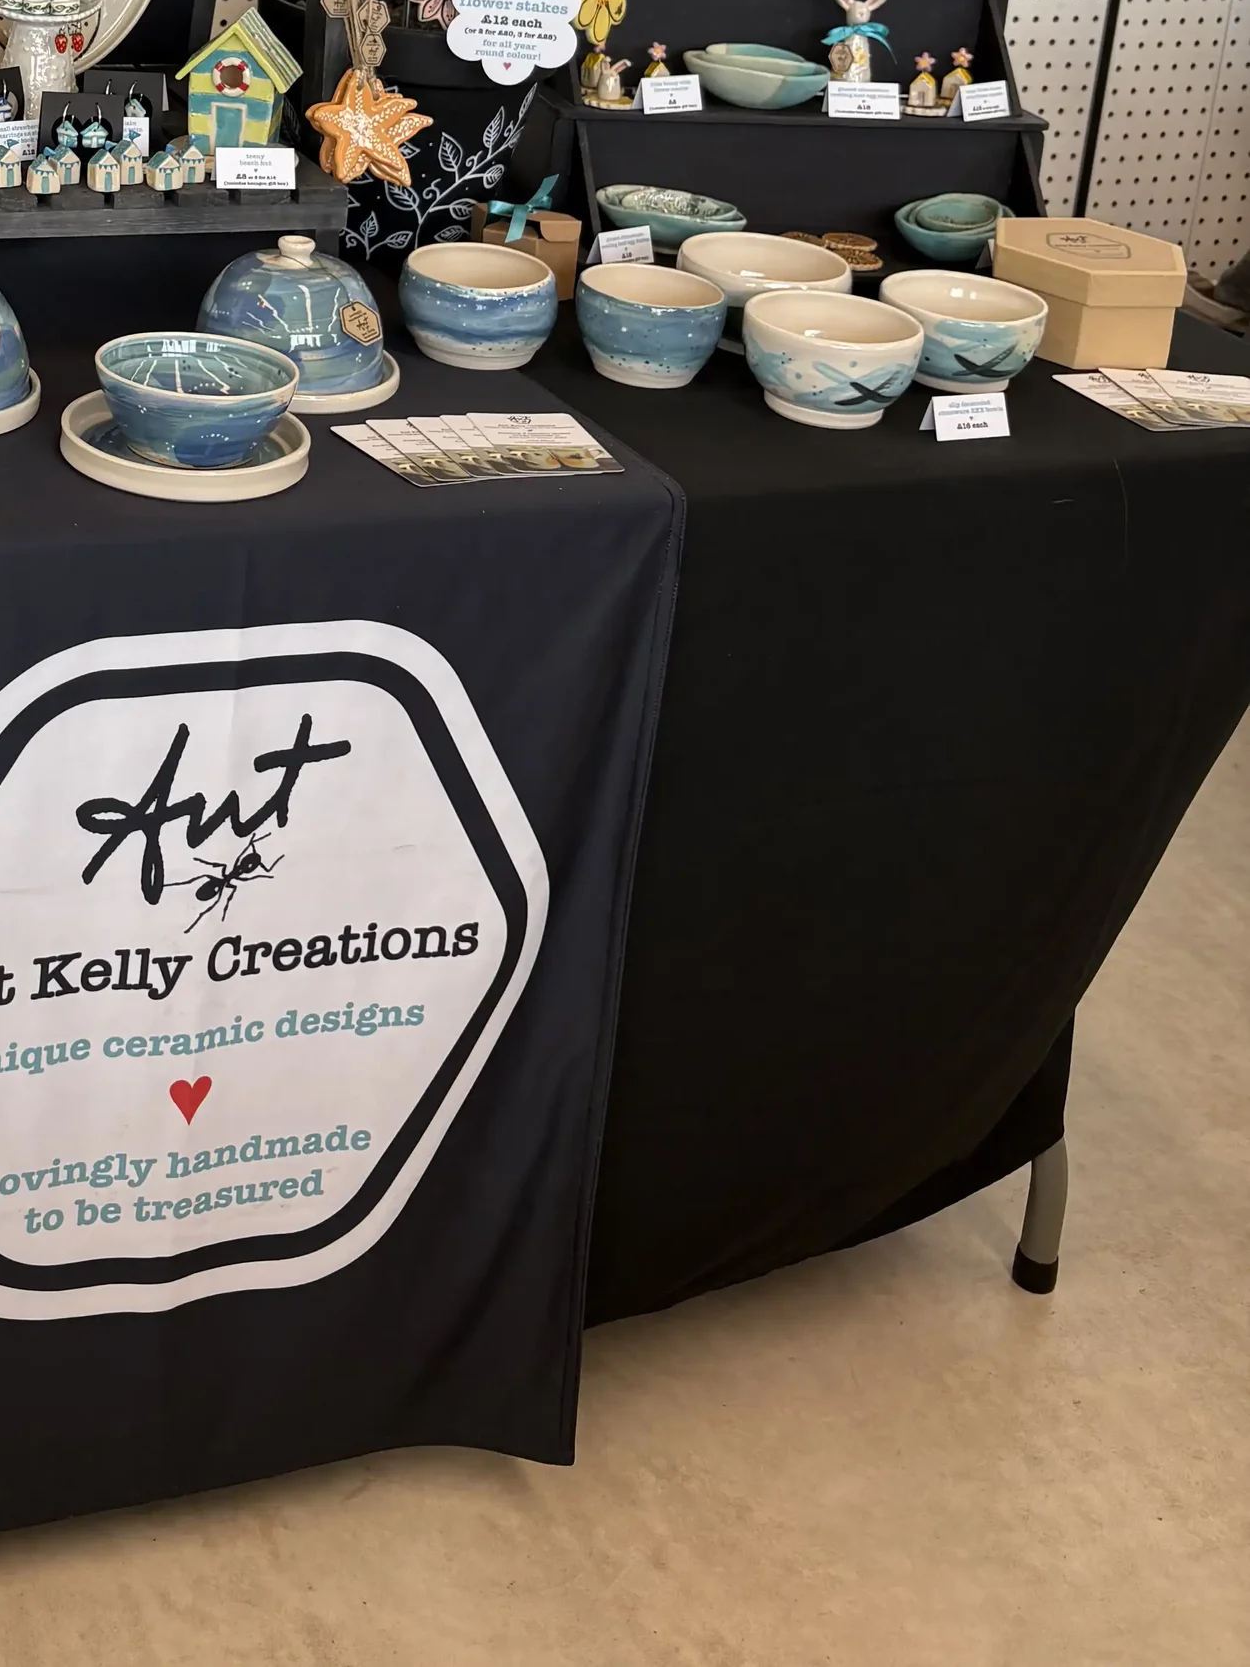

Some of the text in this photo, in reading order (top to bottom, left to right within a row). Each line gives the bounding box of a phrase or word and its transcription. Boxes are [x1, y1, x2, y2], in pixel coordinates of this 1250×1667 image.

[481, 14, 542, 29] £12 each
[516, 2, 568, 15] stakes
[482, 39, 536, 51] for all year
[485, 28, 496, 36] for
[475, 49, 541, 61] round colour!
[76, 713, 351, 904] Ant
[30, 948, 192, 1000] Kelly
[206, 920, 480, 982] Creations
[103, 1015, 265, 1057] ceramic
[275, 1001, 424, 1038] designs
[165, 1125, 372, 1181] handmade
[25, 1168, 324, 1234] to be treasured
